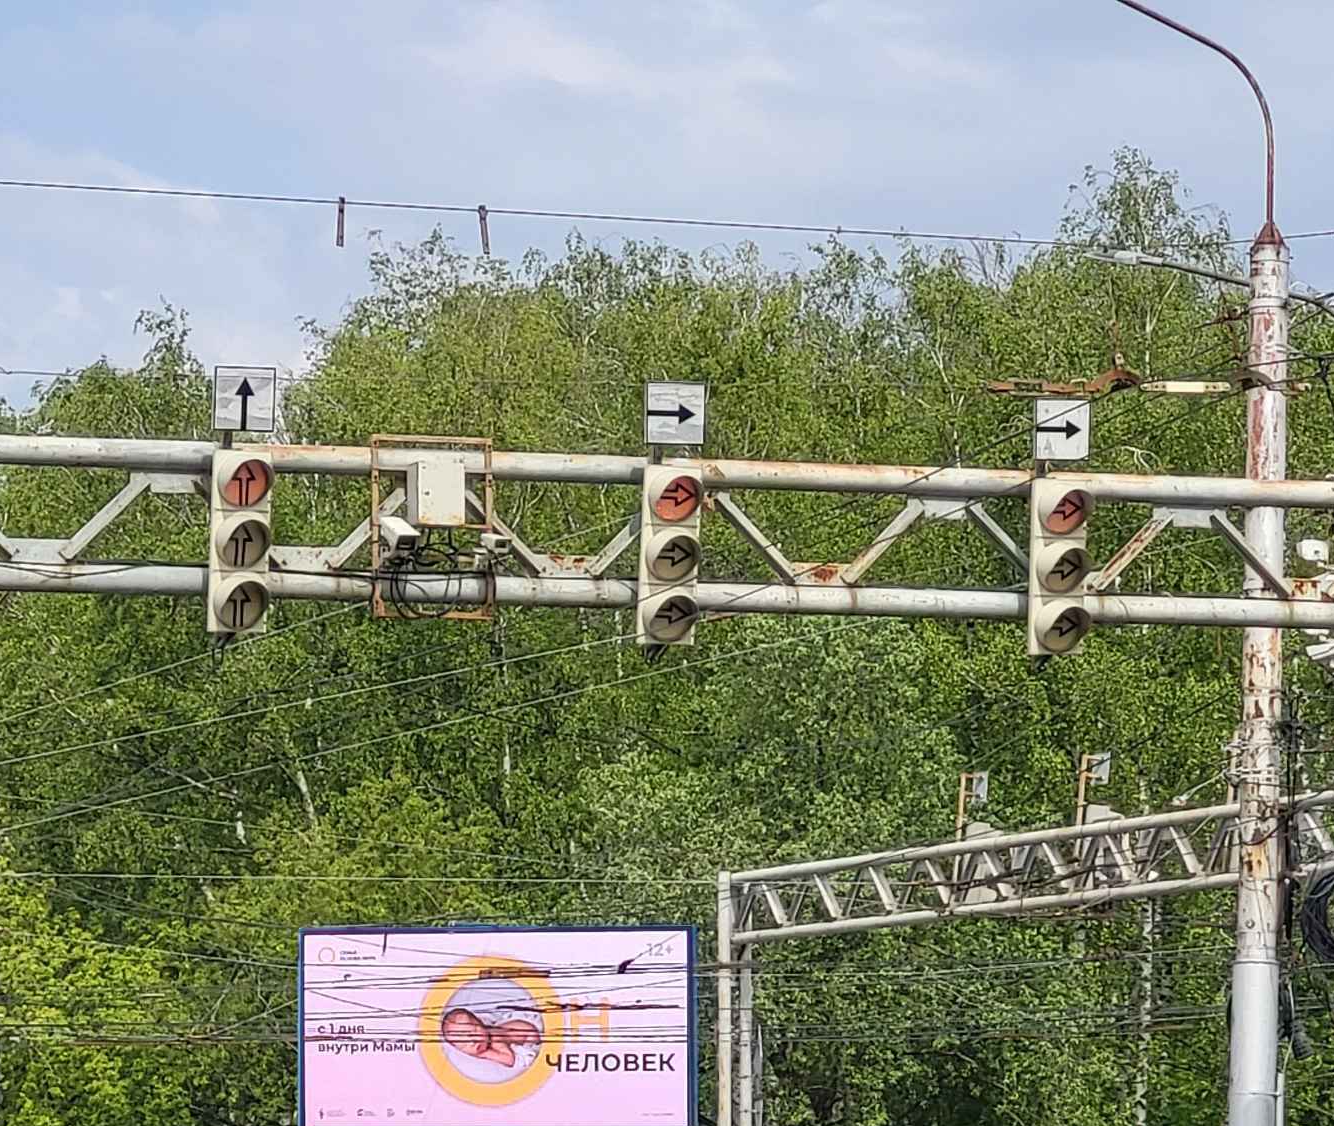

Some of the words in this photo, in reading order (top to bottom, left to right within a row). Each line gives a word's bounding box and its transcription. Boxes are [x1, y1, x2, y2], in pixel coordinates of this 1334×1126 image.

[646, 943, 674, 957] 12+
[317, 1025, 326, 1034] с
[329, 1023, 335, 1034] 1
[338, 1025, 365, 1035] дня
[318, 1043, 368, 1054] внутри
[373, 1041, 415, 1052] Мамы
[545, 1053, 676, 1072] ЧЕЛОВЕК
